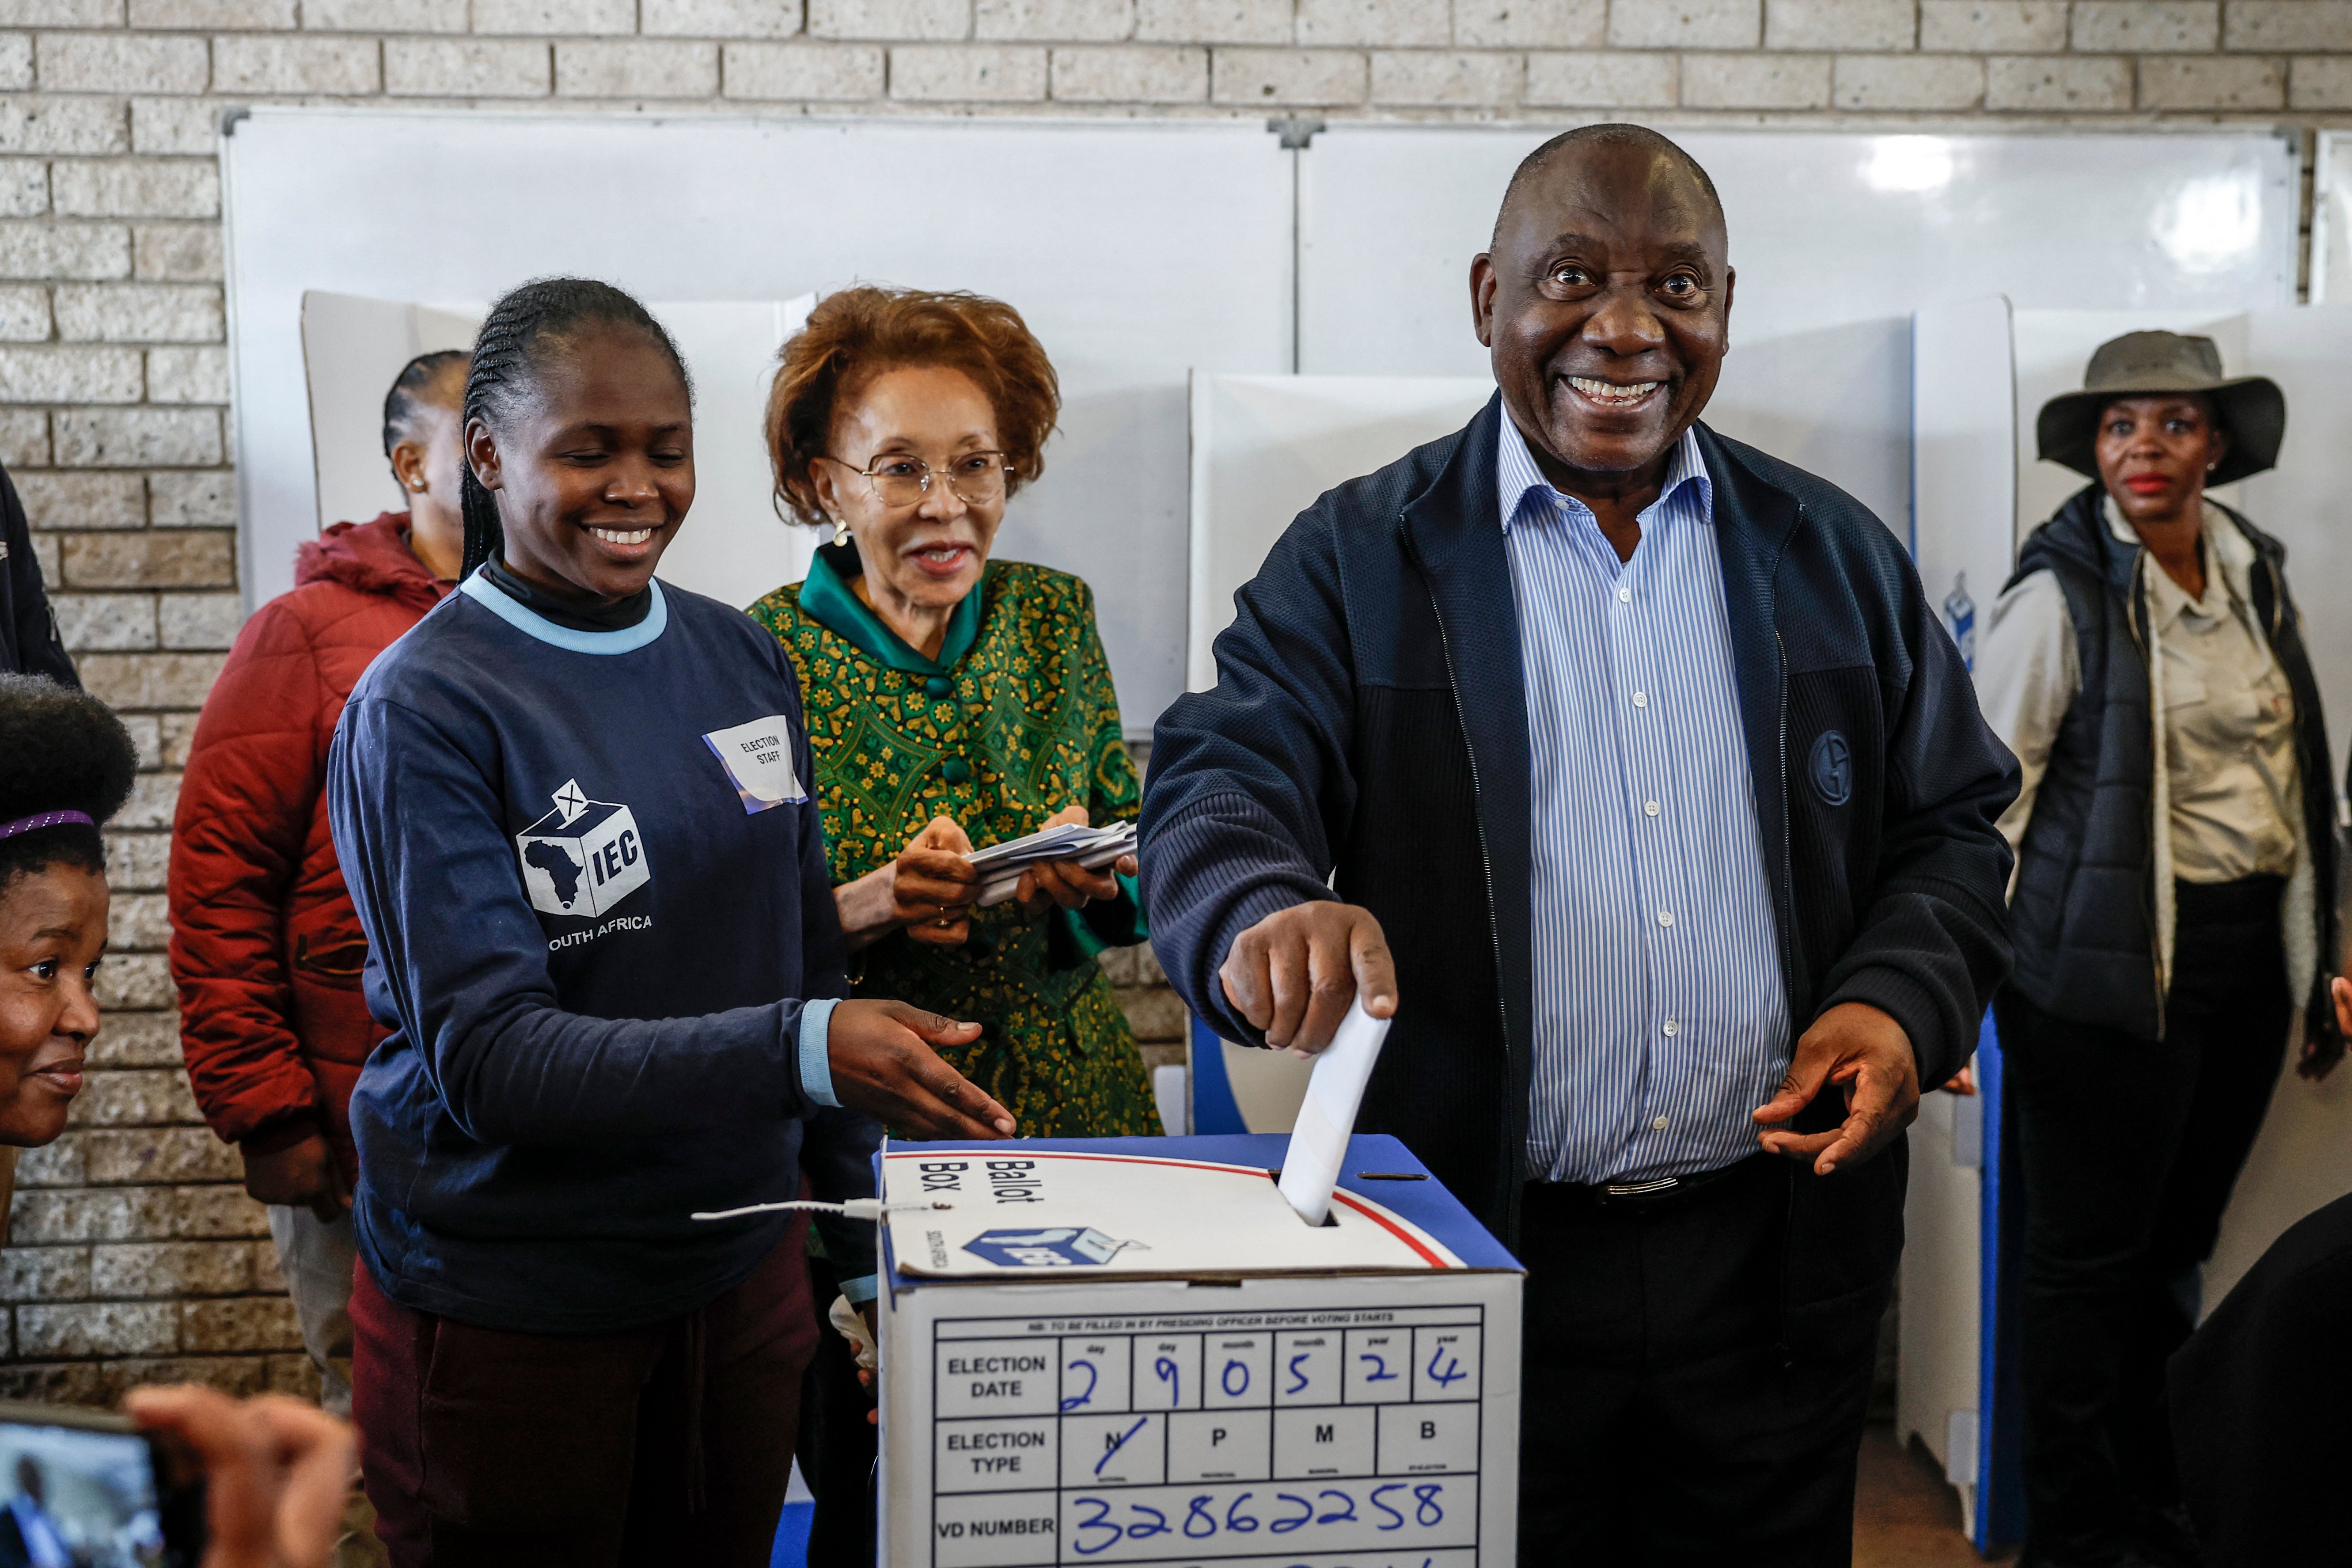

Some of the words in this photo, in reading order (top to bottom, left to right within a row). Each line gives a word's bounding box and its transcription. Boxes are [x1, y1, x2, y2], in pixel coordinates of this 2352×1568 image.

[740, 735, 780, 753] ELECTION
[756, 751, 780, 764] STAFF
[592, 829, 638, 887] IEC
[549, 929, 593, 951] OUTH
[597, 915, 652, 938] AFRICA
[919, 1162, 969, 1192] Box
[986, 1161, 1044, 1204] Ballot
[1157, 1342, 1177, 1353] day
[1367, 1336, 1389, 1346] year
[1437, 1334, 1458, 1345] year
[1086, 1344, 1106, 1355] day
[948, 1356, 1046, 1375] ELECTION
[1061, 1360, 1097, 1412] 2
[1155, 1357, 1179, 1407] 9
[1222, 1359, 1250, 1397] 0
[1286, 1353, 1311, 1394] 5
[1360, 1355, 1398, 1382] 2
[1427, 1347, 1468, 1388] 4
[971, 1381, 1022, 1398] DATE
[1212, 1428, 1227, 1447] P
[1315, 1424, 1334, 1443] M
[1420, 1421, 1436, 1440] B
[947, 1432, 1045, 1451] ELECTION
[971, 1456, 1021, 1474] TYPE
[938, 1522, 964, 1538] VD
[970, 1518, 1055, 1537] NUMBER
[1074, 1483, 1444, 1555] 32862258
